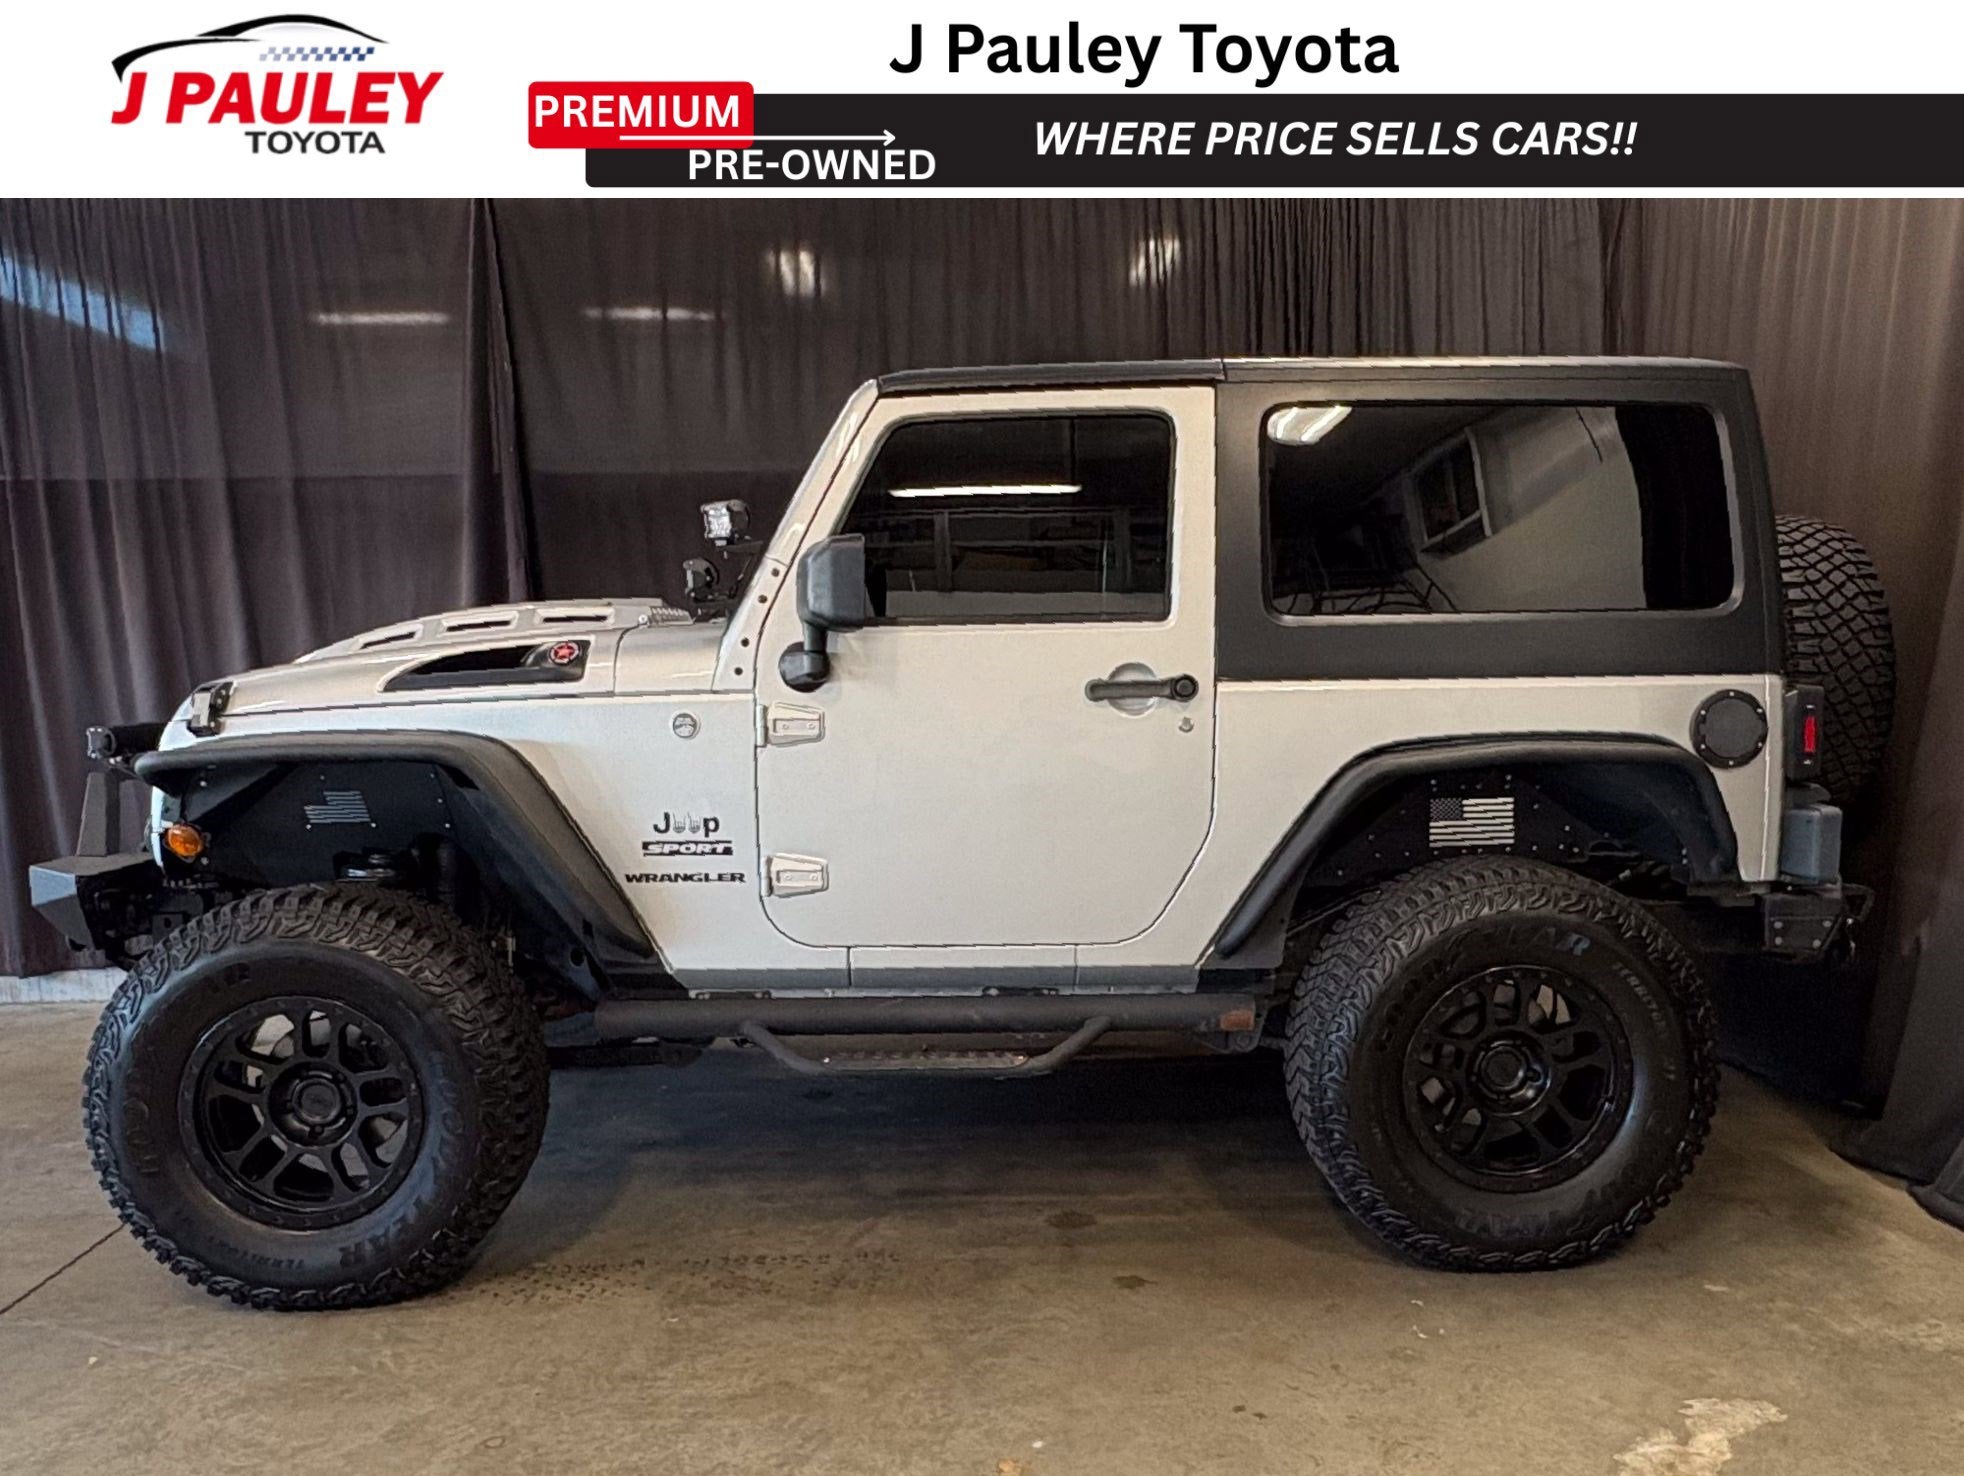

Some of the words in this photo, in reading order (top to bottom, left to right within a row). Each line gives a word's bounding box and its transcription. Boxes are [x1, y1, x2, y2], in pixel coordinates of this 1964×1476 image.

[653, 811, 720, 838] Jp
[646, 842, 731, 854] SPORT
[625, 872, 746, 883] WRANGLER
